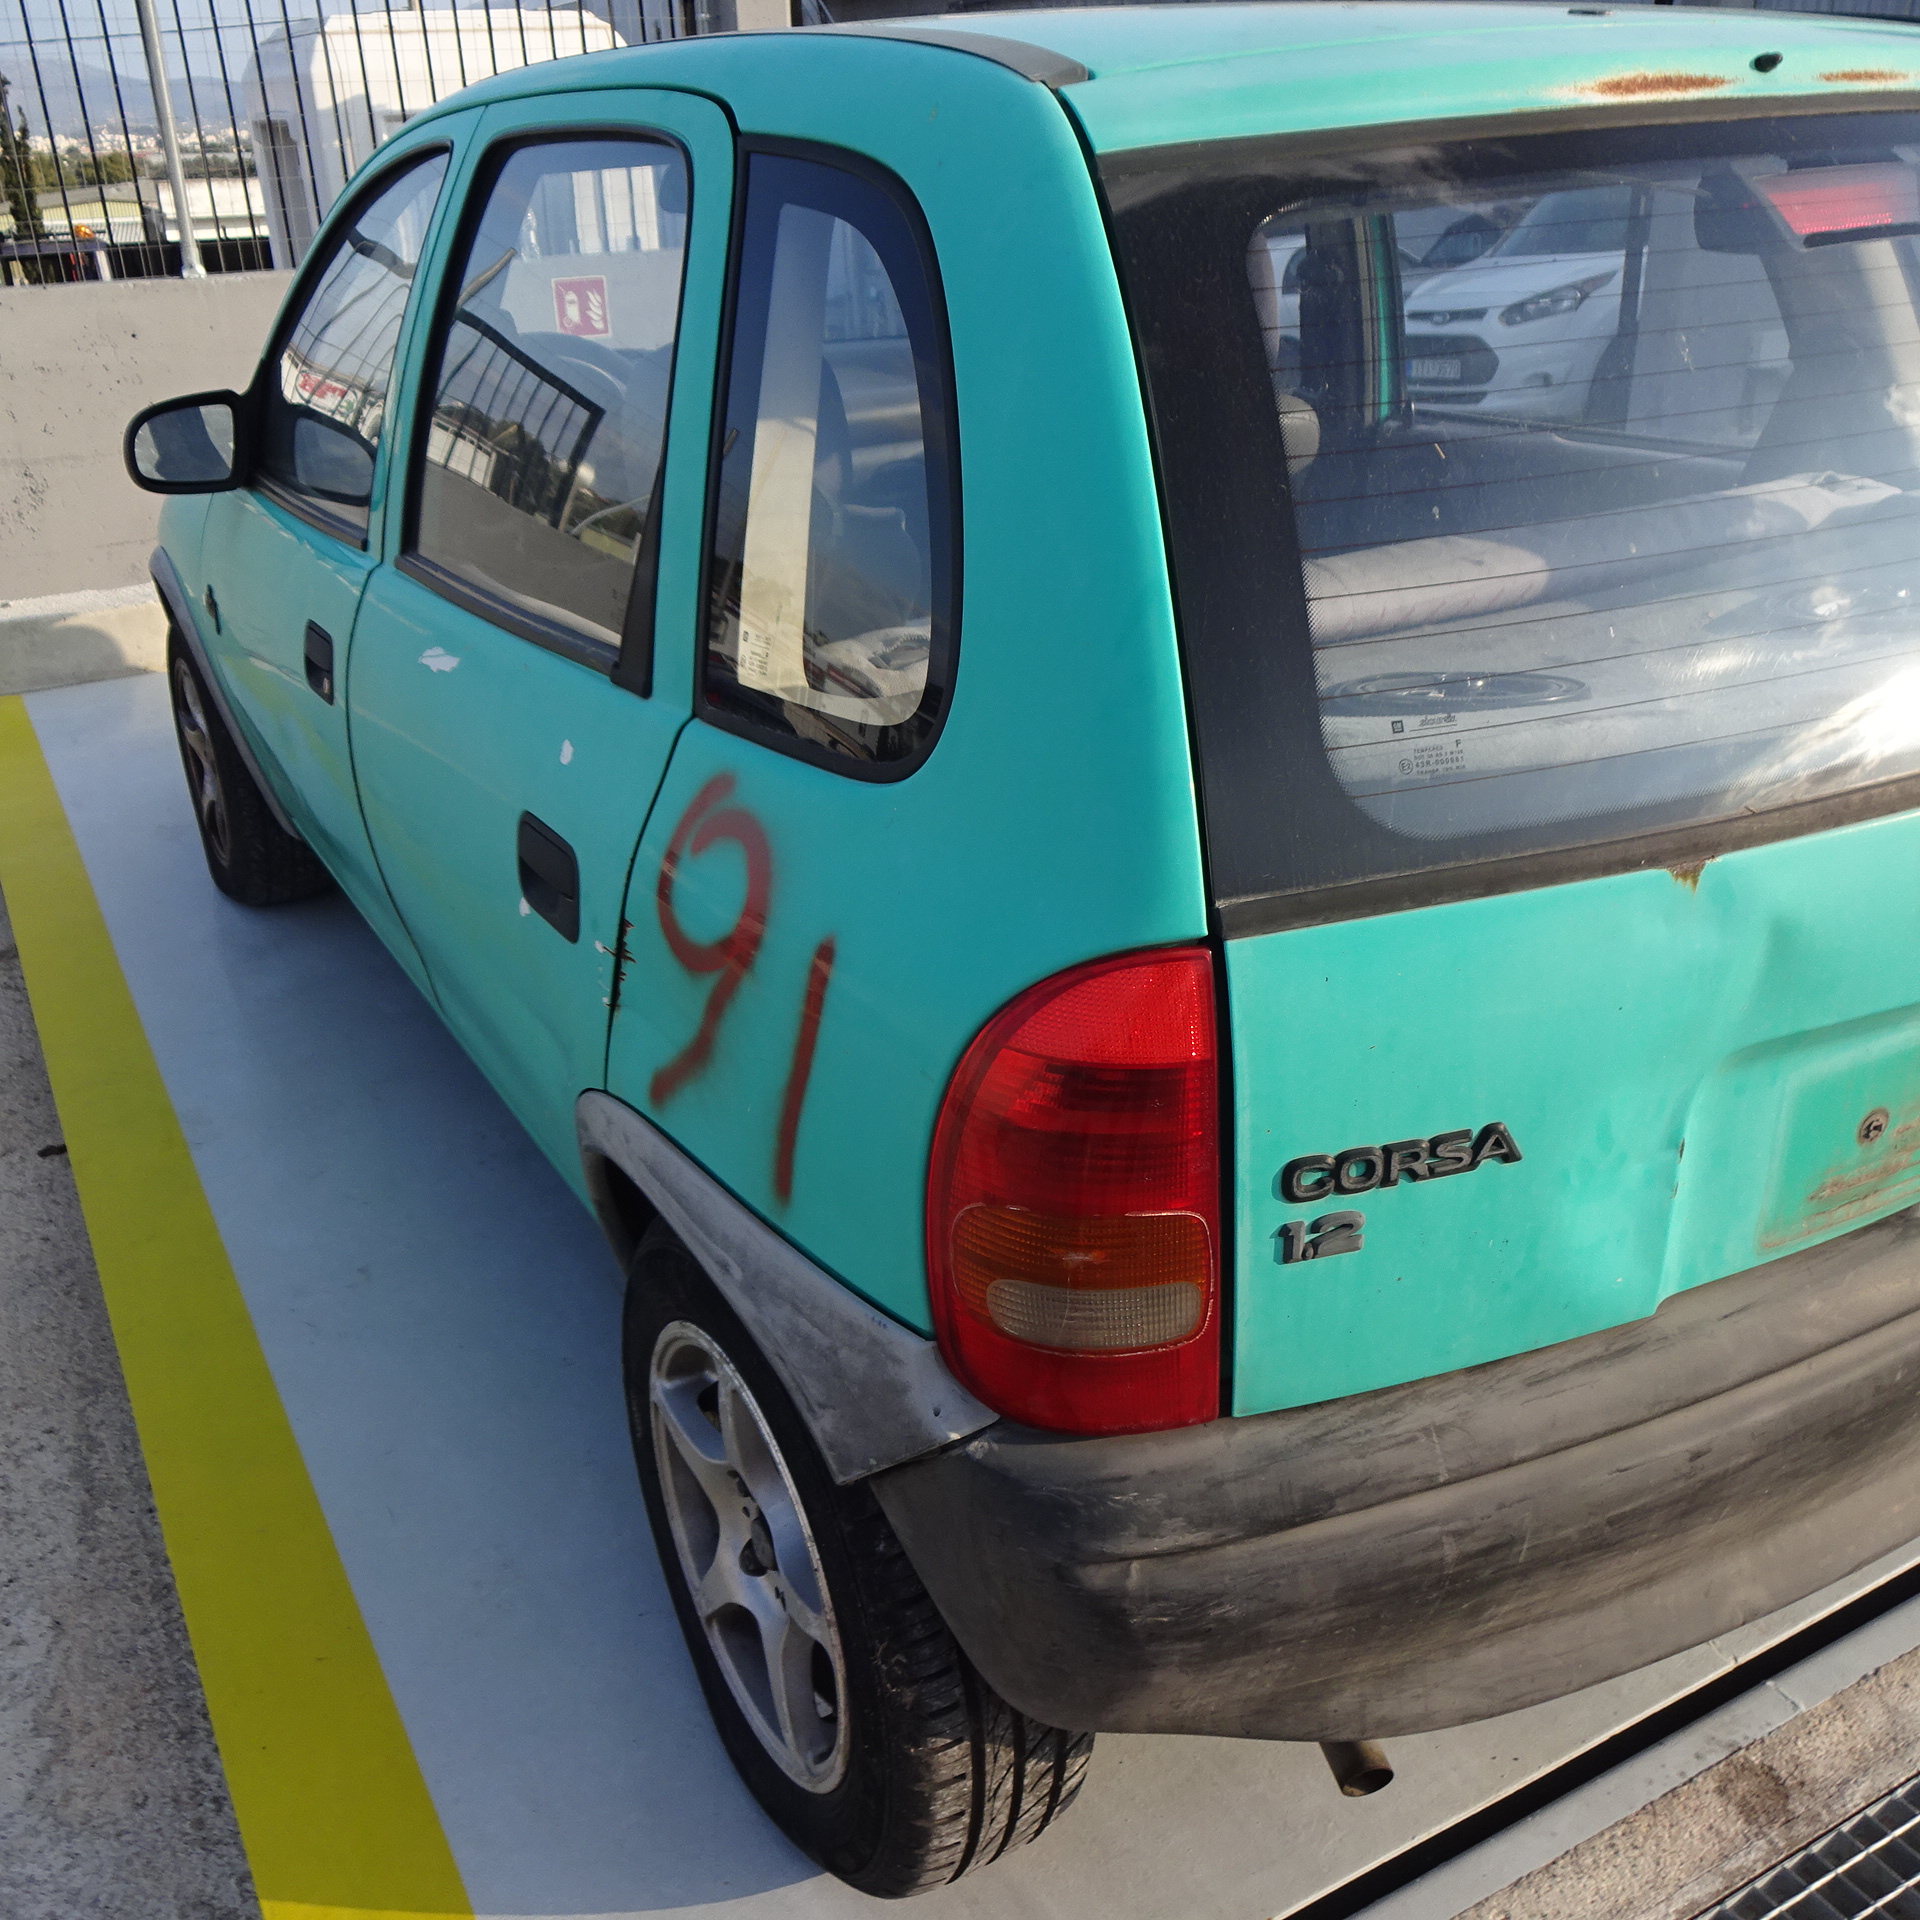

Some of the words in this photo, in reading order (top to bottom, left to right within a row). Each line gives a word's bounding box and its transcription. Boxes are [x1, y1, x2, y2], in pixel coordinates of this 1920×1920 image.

[650, 771, 836, 1207] 91
[1279, 1121, 1523, 1203] CORSA
[1277, 1210, 1364, 1264] 1.2
